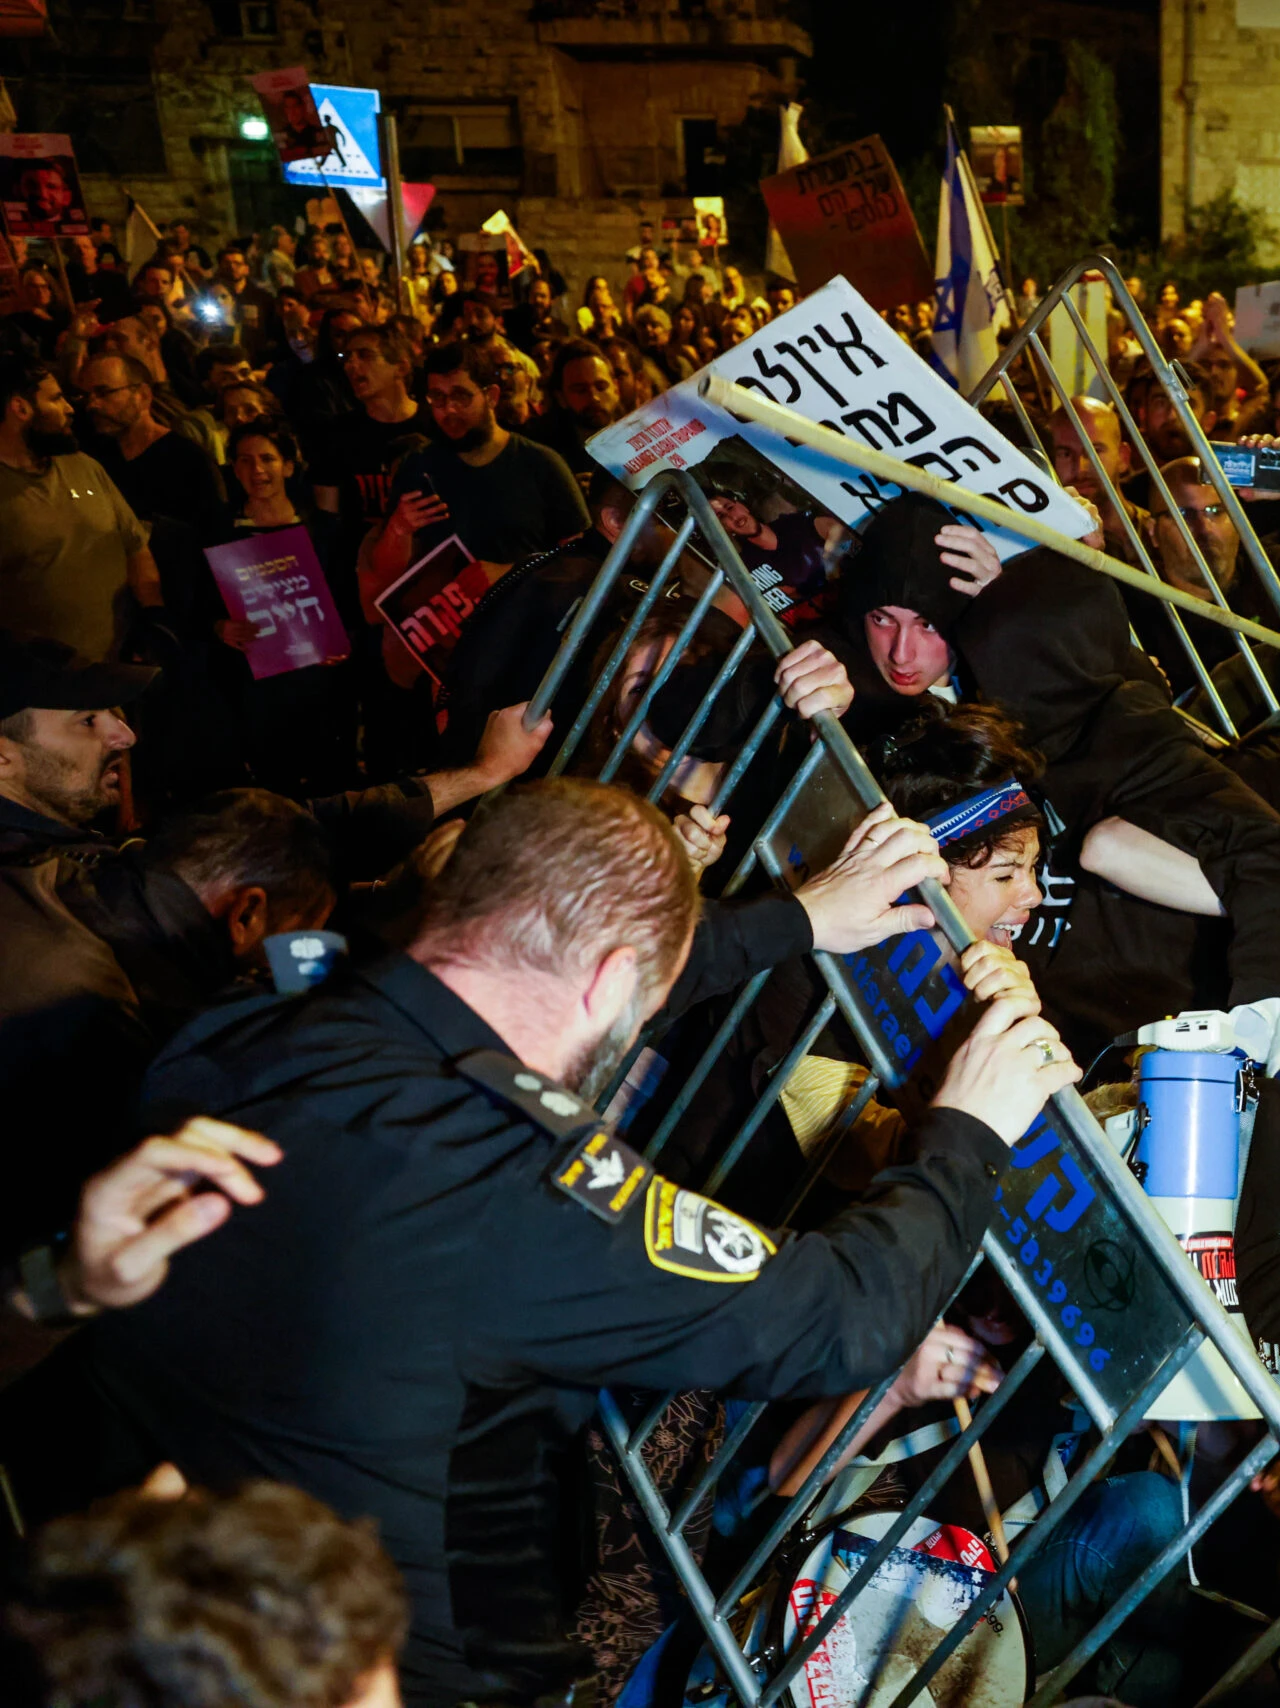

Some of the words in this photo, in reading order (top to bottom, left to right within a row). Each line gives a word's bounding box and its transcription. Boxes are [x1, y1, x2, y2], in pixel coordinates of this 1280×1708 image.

[774, 311, 888, 408] אין
[749, 563, 784, 592] RING
[400, 581, 481, 654] פקרה
